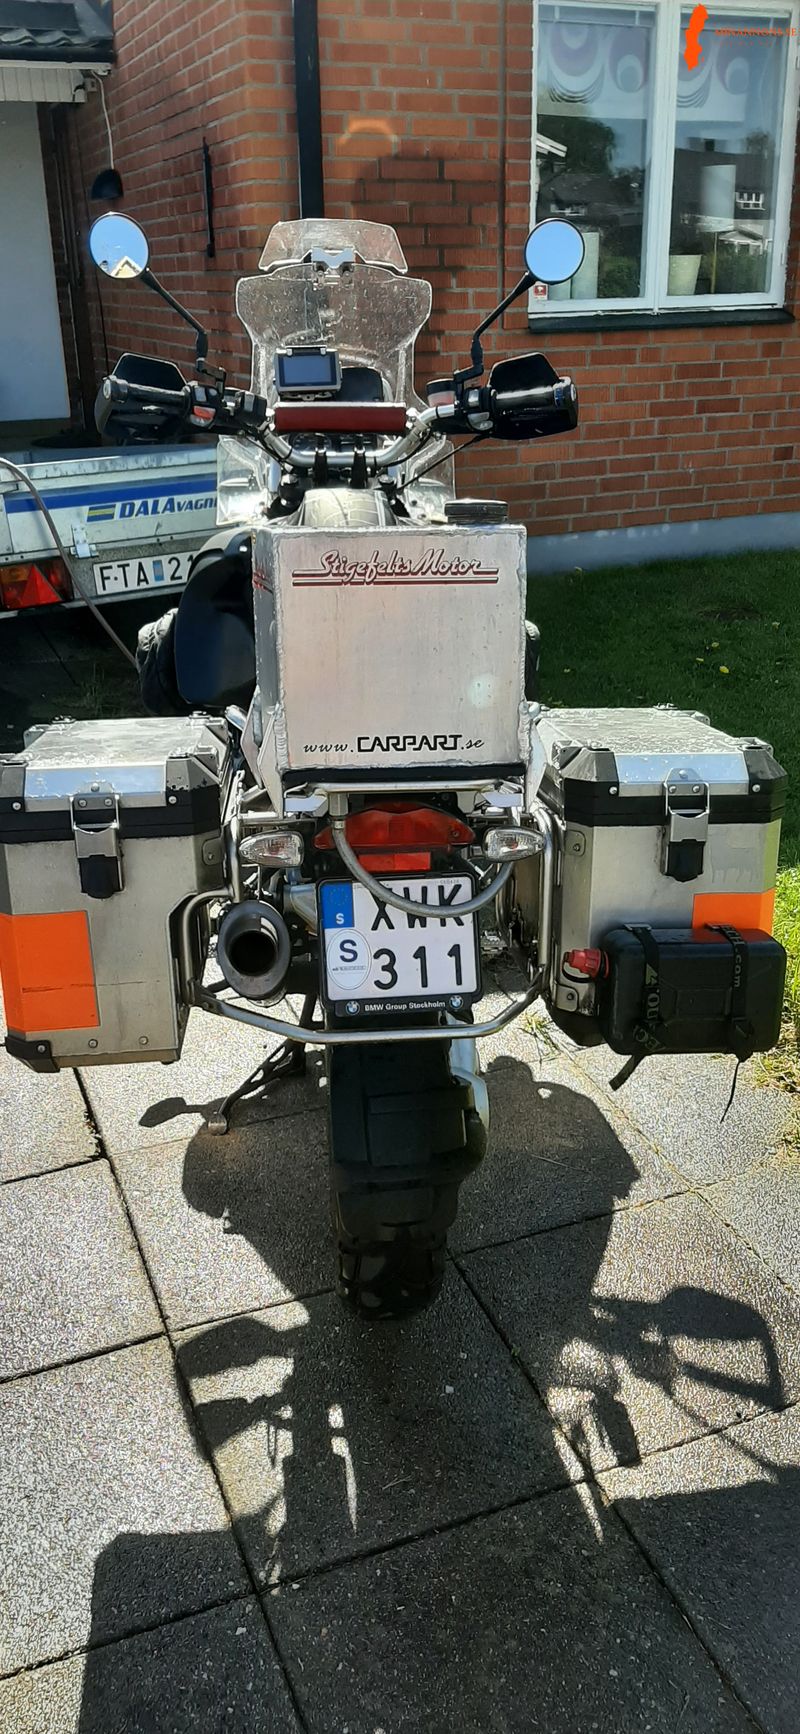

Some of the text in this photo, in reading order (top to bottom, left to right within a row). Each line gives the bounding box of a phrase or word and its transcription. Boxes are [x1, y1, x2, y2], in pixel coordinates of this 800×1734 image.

[336, 913, 345, 925] S
[371, 884, 464, 931] XWK
[339, 939, 358, 963] S
[373, 944, 463, 991] 311
[365, 1000, 446, 1012] BMW Group Stockholm
